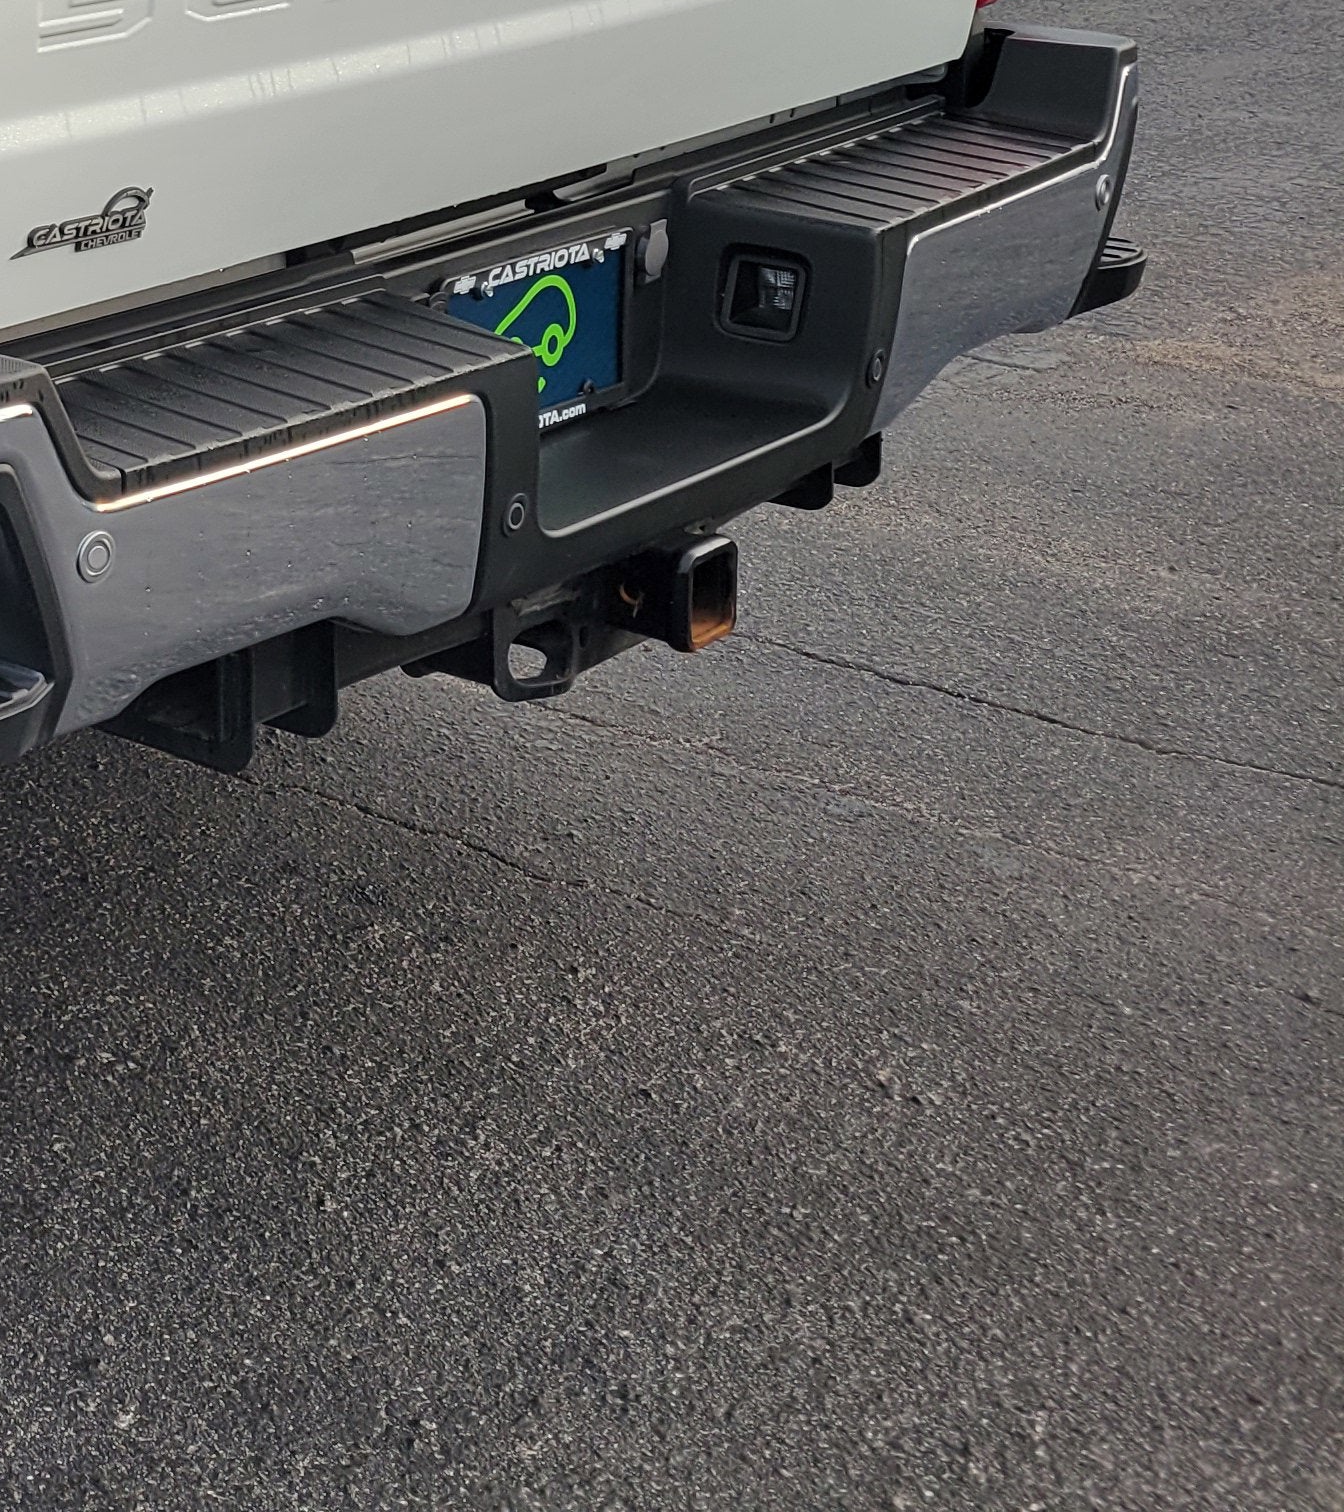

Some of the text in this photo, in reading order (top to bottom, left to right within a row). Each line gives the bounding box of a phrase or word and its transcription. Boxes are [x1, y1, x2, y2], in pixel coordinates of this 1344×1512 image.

[32, 209, 146, 248] CASTRIOTA
[80, 229, 144, 251] CHEVROLET
[487, 243, 591, 287] CASTRIOTA
